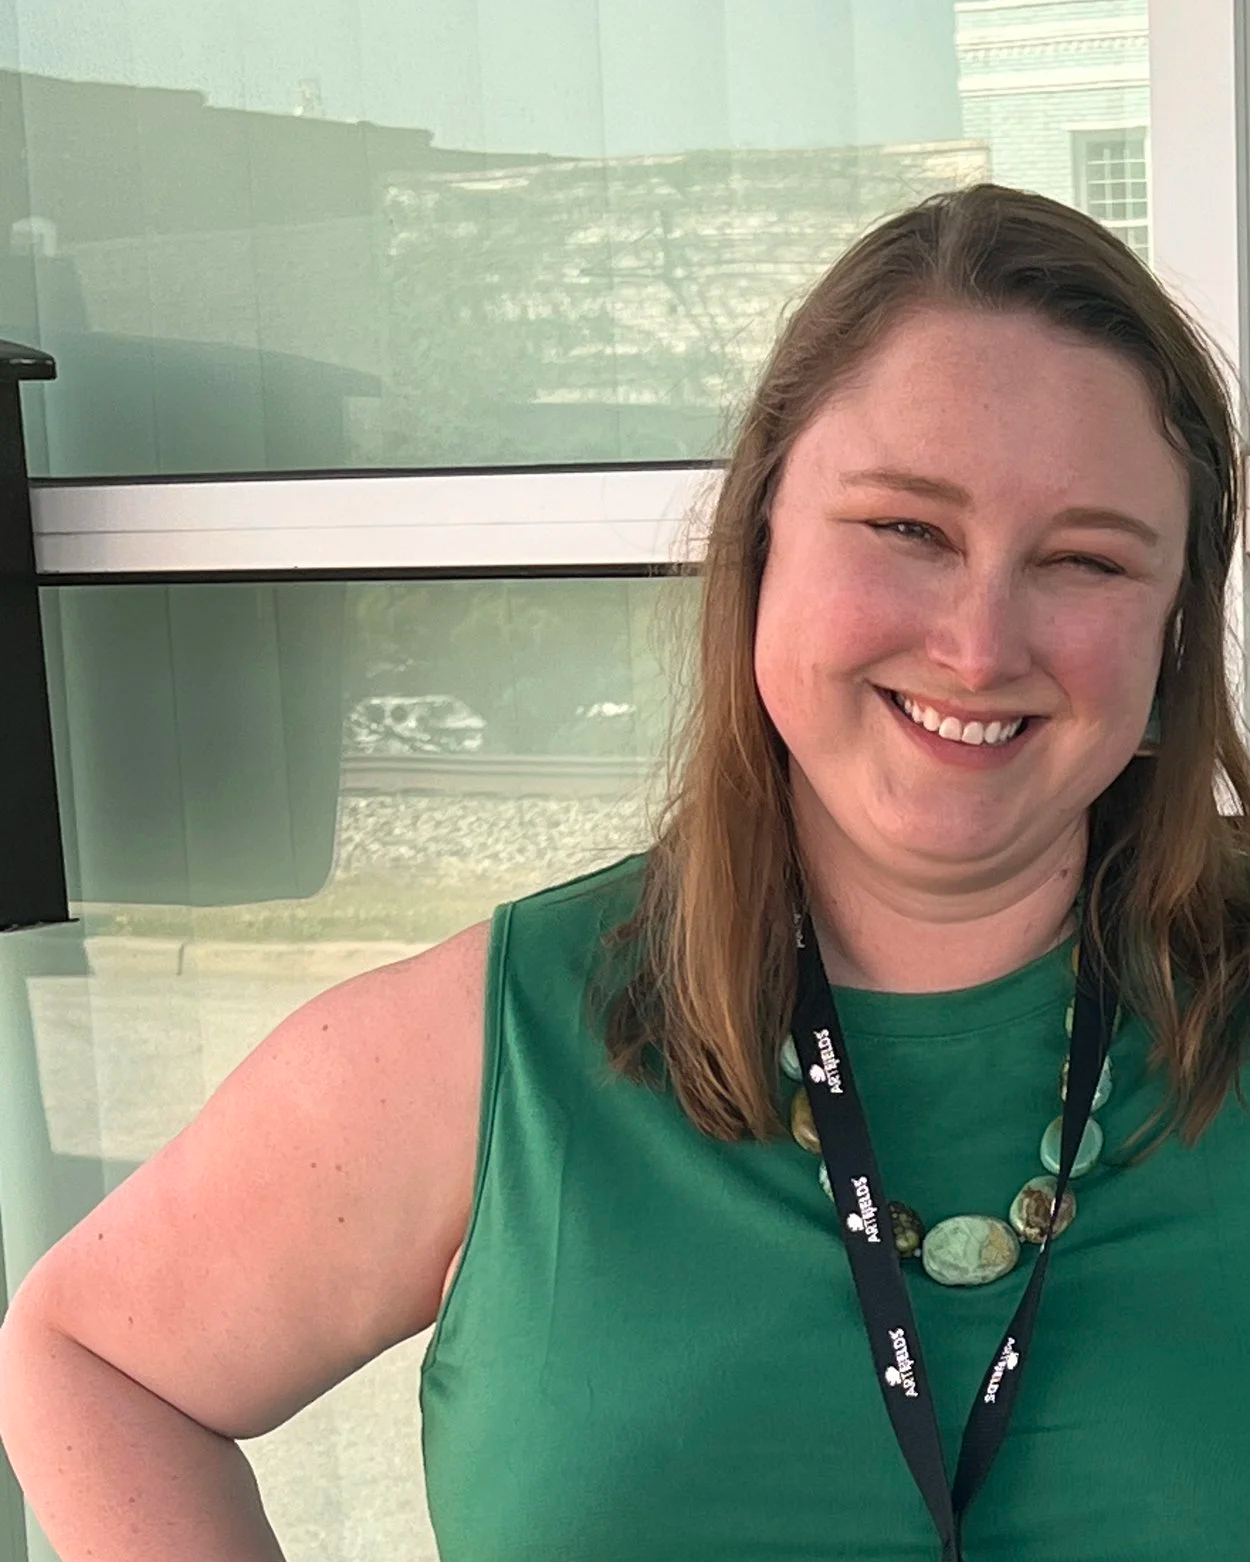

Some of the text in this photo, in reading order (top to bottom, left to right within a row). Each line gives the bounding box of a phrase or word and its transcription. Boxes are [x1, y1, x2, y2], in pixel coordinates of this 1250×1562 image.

[813, 1028, 843, 1094] ARTFIELDS
[850, 1176, 881, 1242] ARTFIELDS
[888, 1328, 918, 1397] ARTFIELDS
